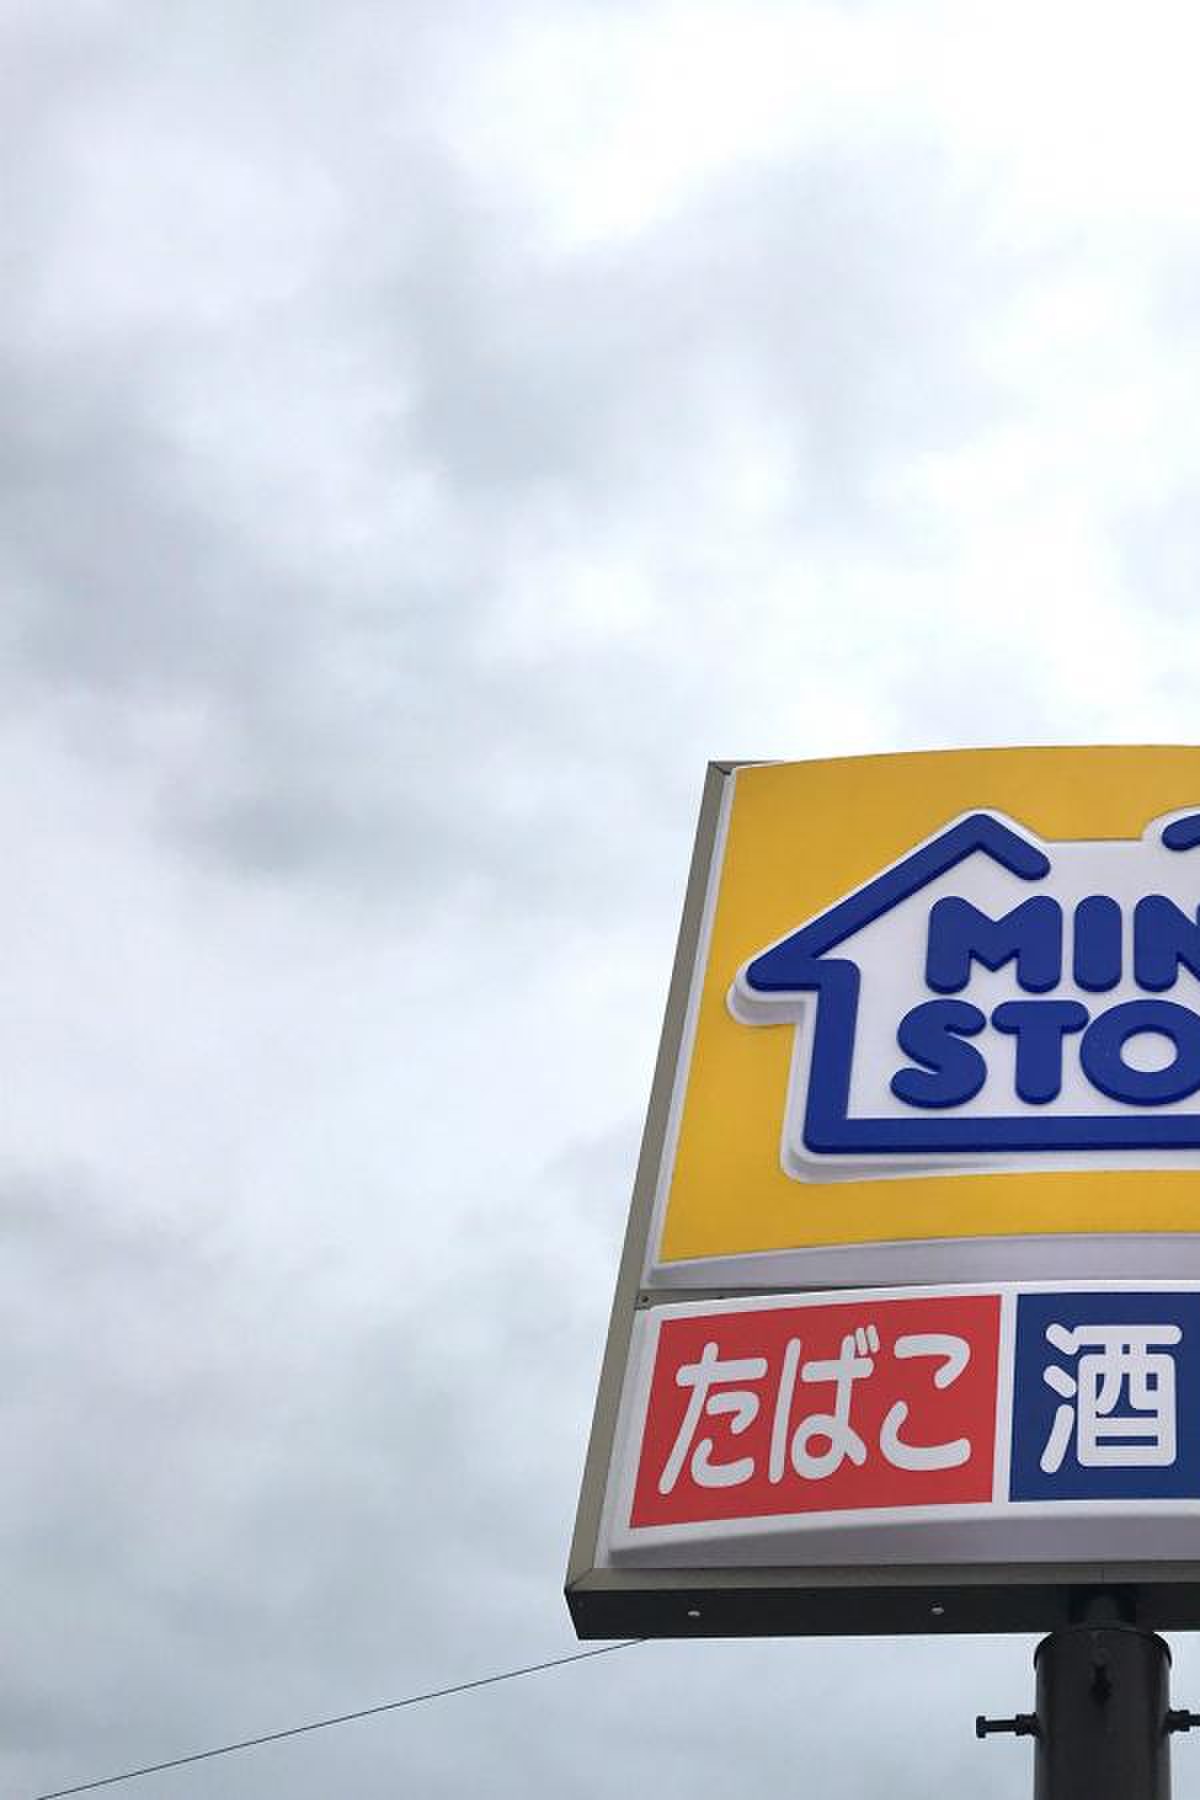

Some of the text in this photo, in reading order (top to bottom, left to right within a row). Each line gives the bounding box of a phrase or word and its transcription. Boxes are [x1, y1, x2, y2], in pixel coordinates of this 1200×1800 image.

[658, 1324, 973, 1496] たばこ
[1039, 1323, 1182, 1474] 酒
